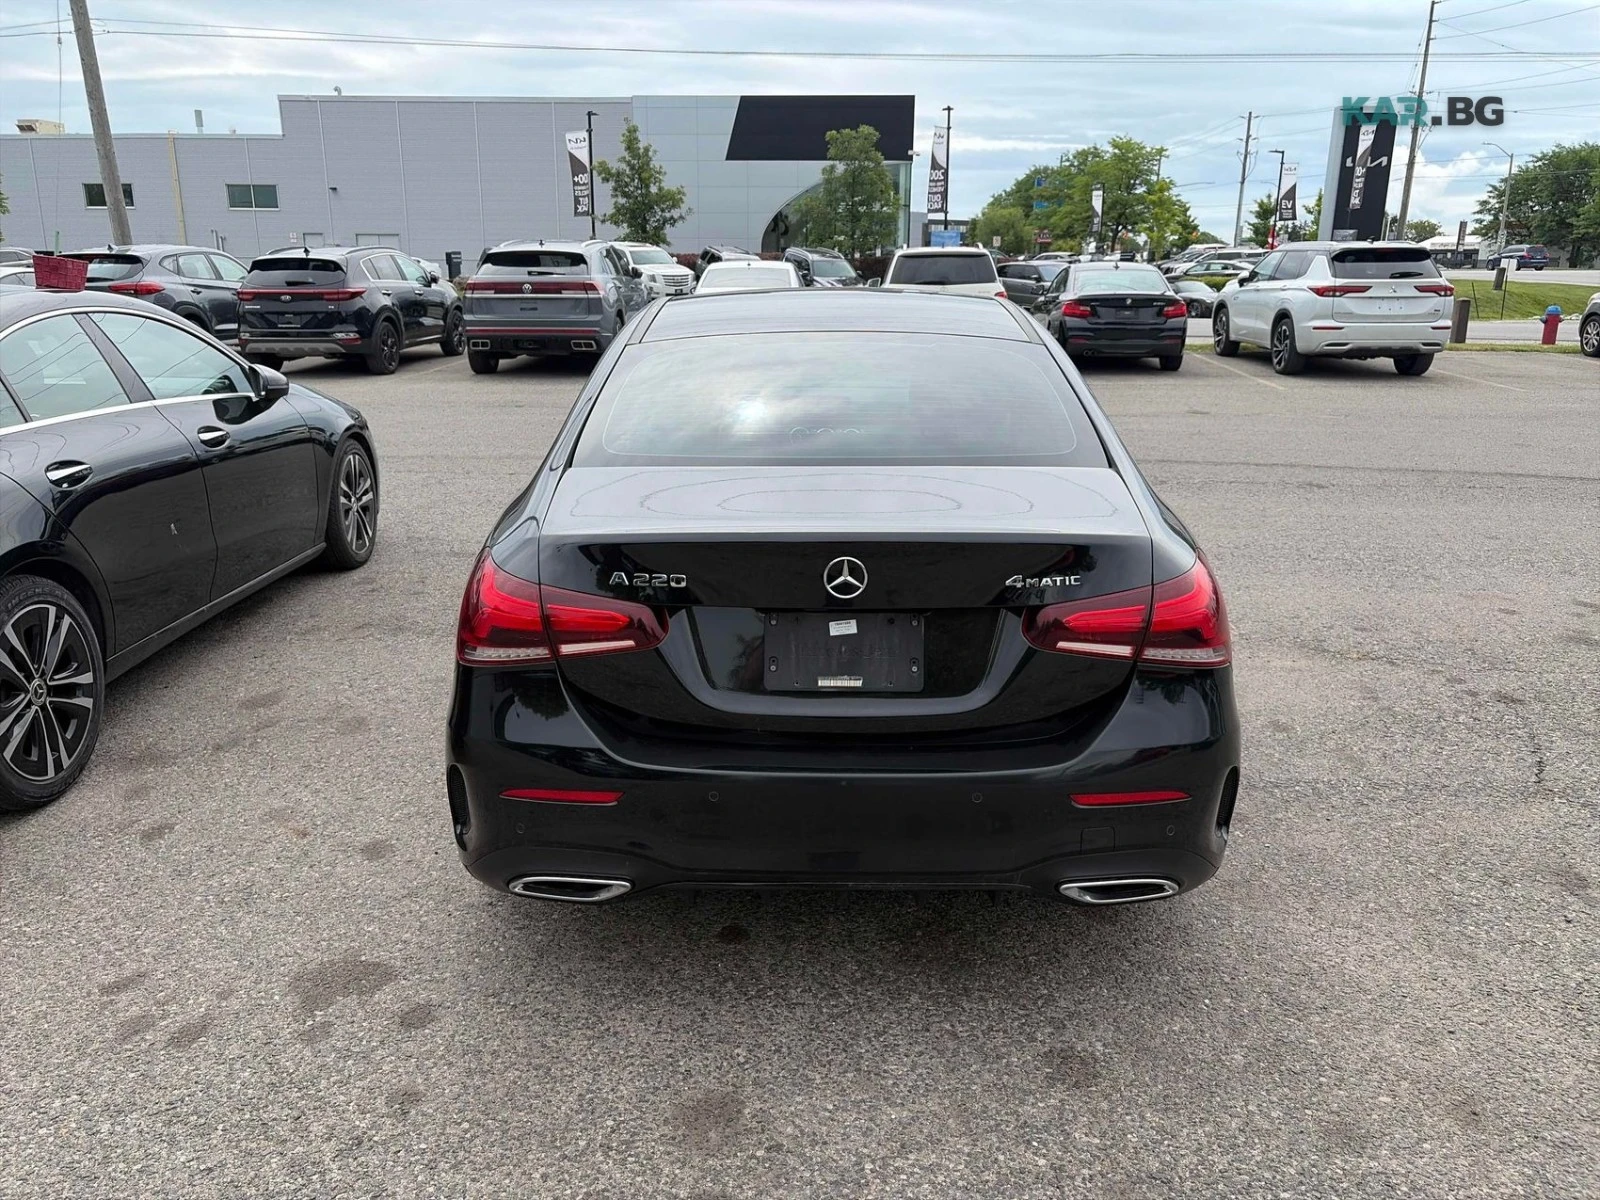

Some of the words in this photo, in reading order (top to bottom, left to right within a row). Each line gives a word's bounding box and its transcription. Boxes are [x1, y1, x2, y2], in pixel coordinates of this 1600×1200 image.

[1281, 200, 1293, 209] EV
[632, 572, 687, 588] 220
[1005, 574, 1081, 588] 4MATIC
